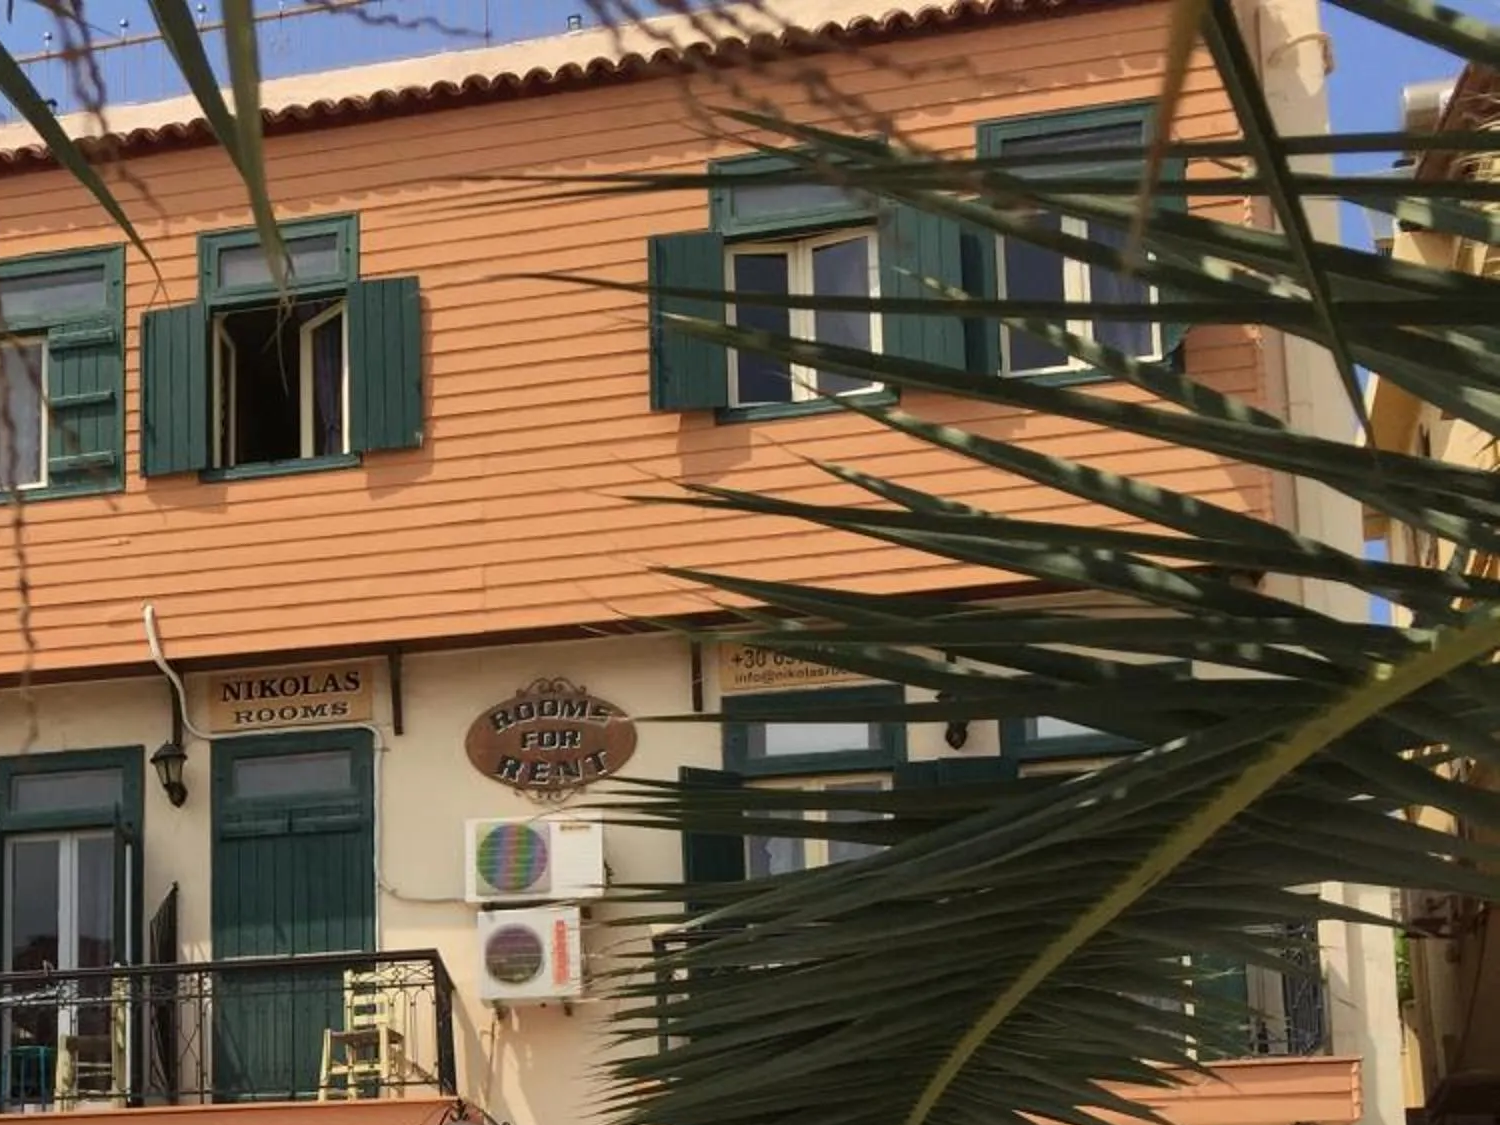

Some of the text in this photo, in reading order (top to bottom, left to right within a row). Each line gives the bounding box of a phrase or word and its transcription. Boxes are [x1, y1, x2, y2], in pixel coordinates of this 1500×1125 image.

[222, 671, 361, 702] NIKOLAS
[235, 702, 349, 724] ROOMS
[490, 699, 613, 733] ROOMS
[521, 731, 581, 750] FOR
[498, 750, 608, 785] RENT
